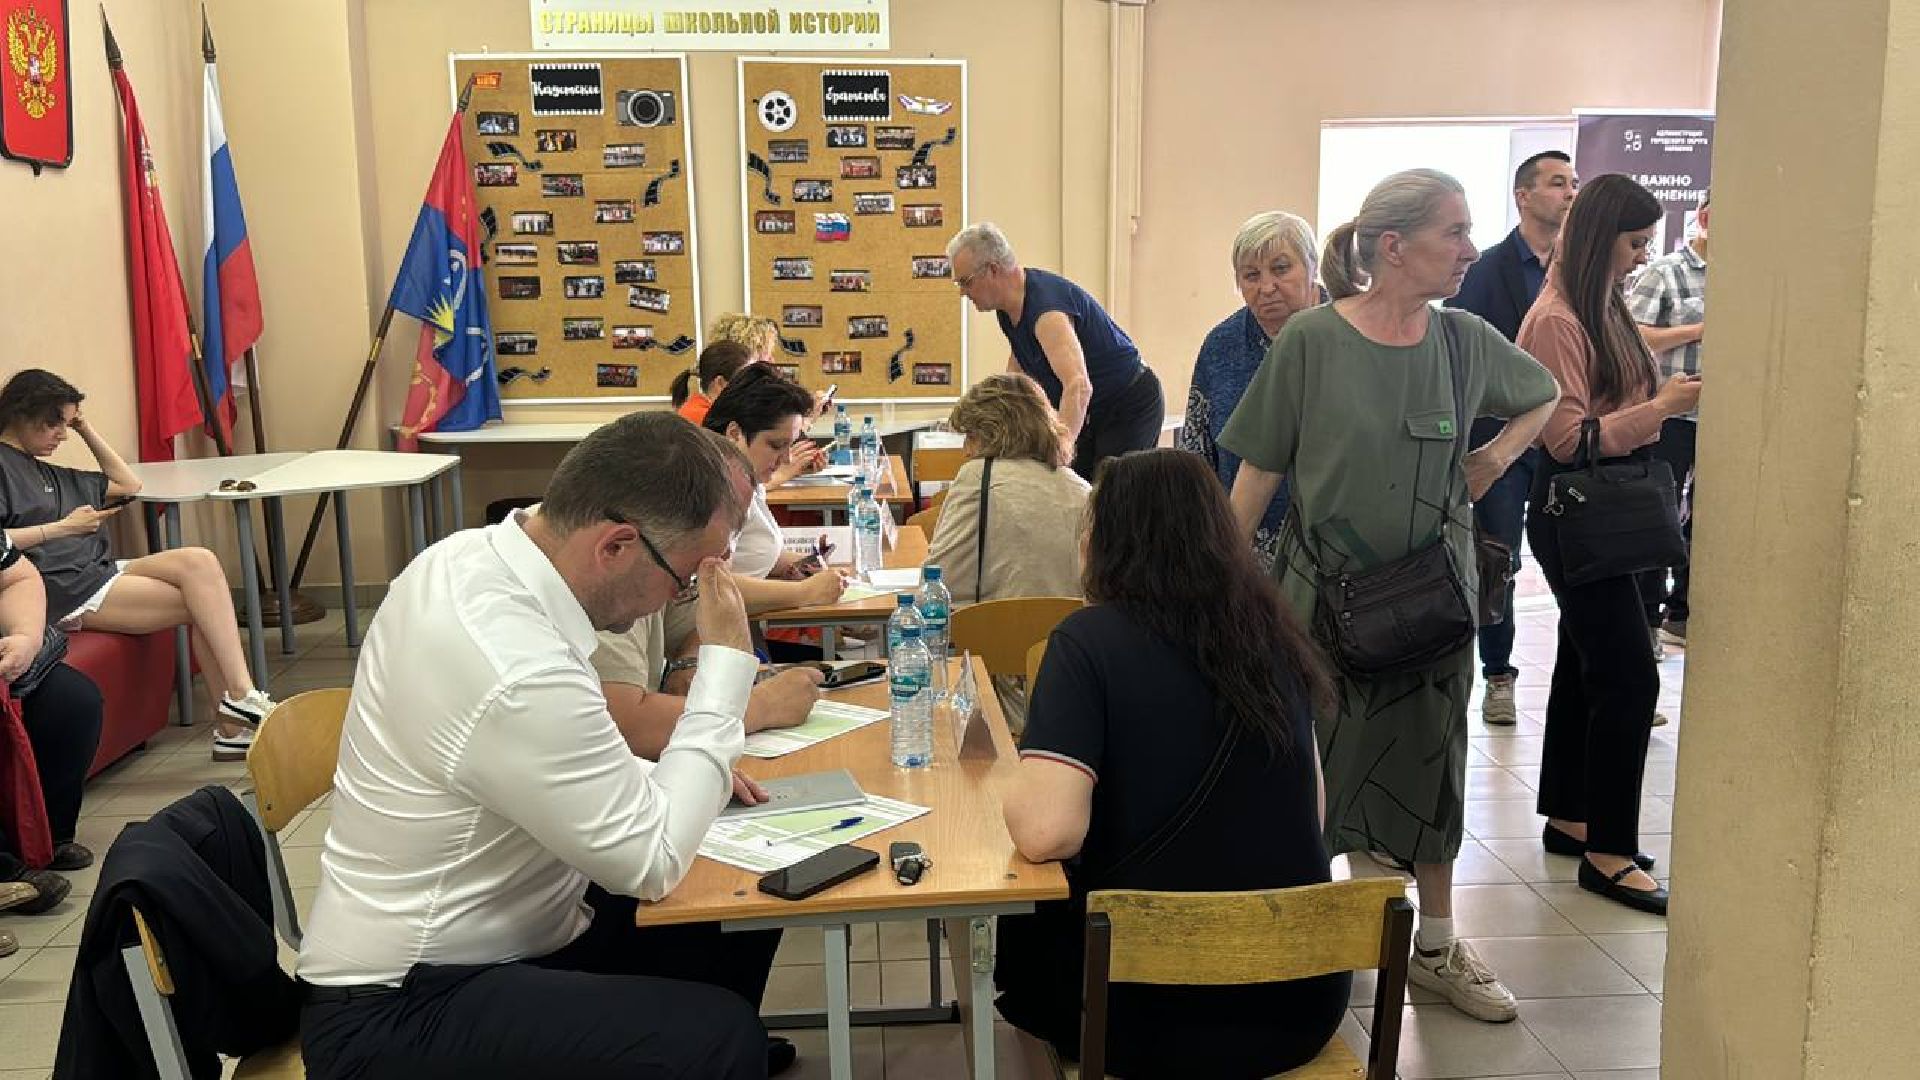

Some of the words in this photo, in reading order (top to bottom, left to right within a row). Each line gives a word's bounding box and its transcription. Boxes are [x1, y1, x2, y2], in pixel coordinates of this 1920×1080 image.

[540, 10, 654, 36] СТРАНИЦЫ
[663, 7, 780, 34] ШКОЛЬНОЙ
[789, 11, 880, 34] ИСТОРИИ
[1640, 175, 1691, 186] ВАЖНО
